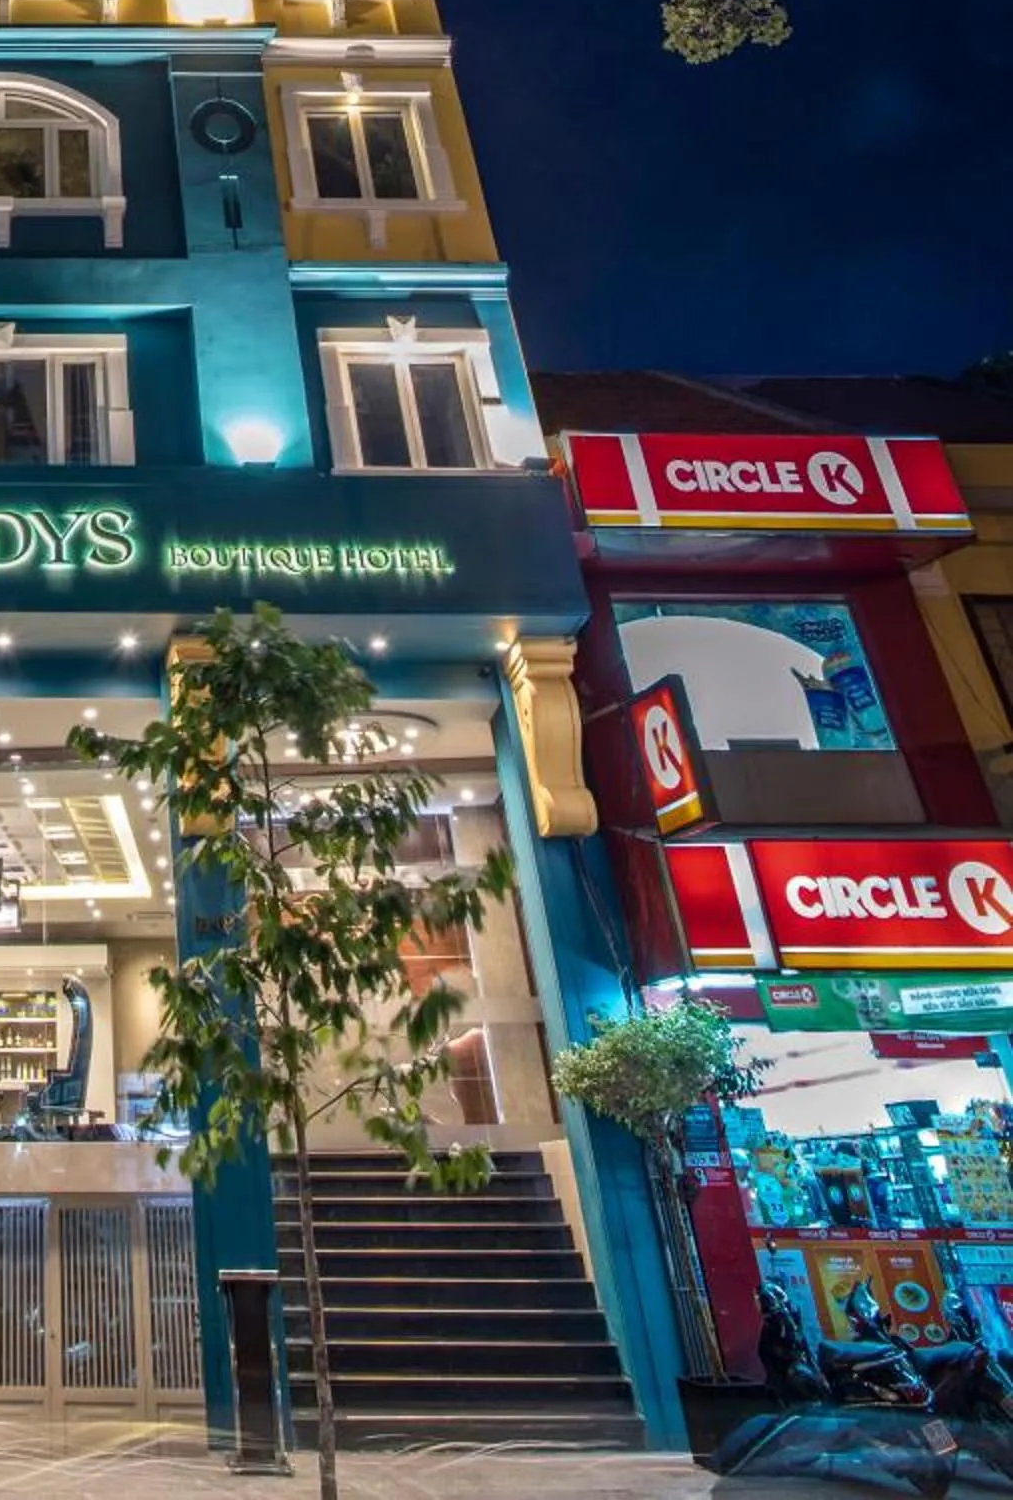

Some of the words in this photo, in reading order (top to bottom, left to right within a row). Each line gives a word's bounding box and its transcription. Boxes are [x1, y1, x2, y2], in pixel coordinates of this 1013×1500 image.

[665, 459, 804, 494] CIRCLE
[816, 459, 864, 500] K
[169, 544, 335, 575] BOUTIQUE
[341, 544, 456, 576] HOTEL
[785, 875, 948, 920] CIRCLE
[959, 870, 1013, 929] K
